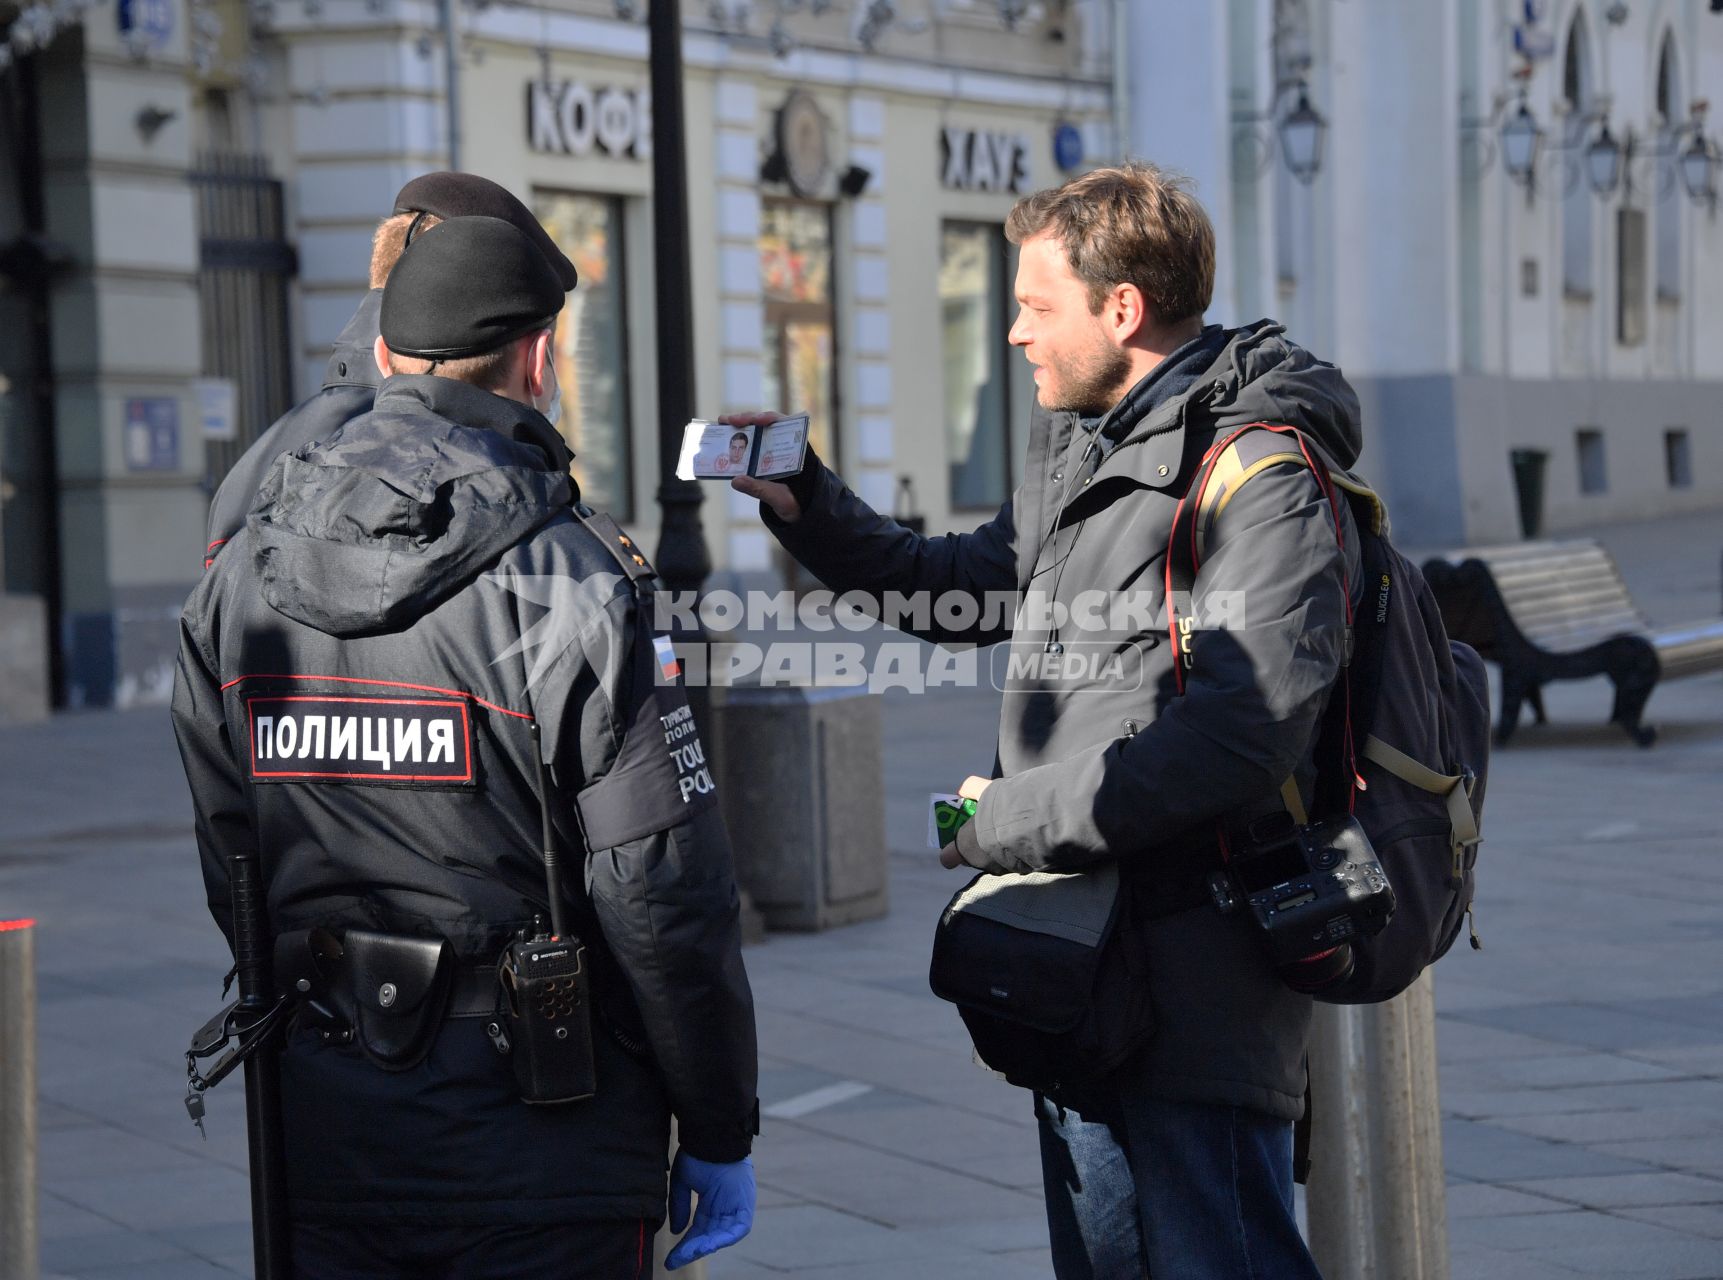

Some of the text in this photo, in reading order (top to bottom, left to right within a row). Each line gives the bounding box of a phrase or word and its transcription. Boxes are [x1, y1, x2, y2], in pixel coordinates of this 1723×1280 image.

[942, 127, 1031, 194] ХАУЗ
[257, 715, 456, 771] ПОЛИЦИЯ
[664, 719, 697, 745] ПОЛИ
[669, 738, 706, 774] TOU
